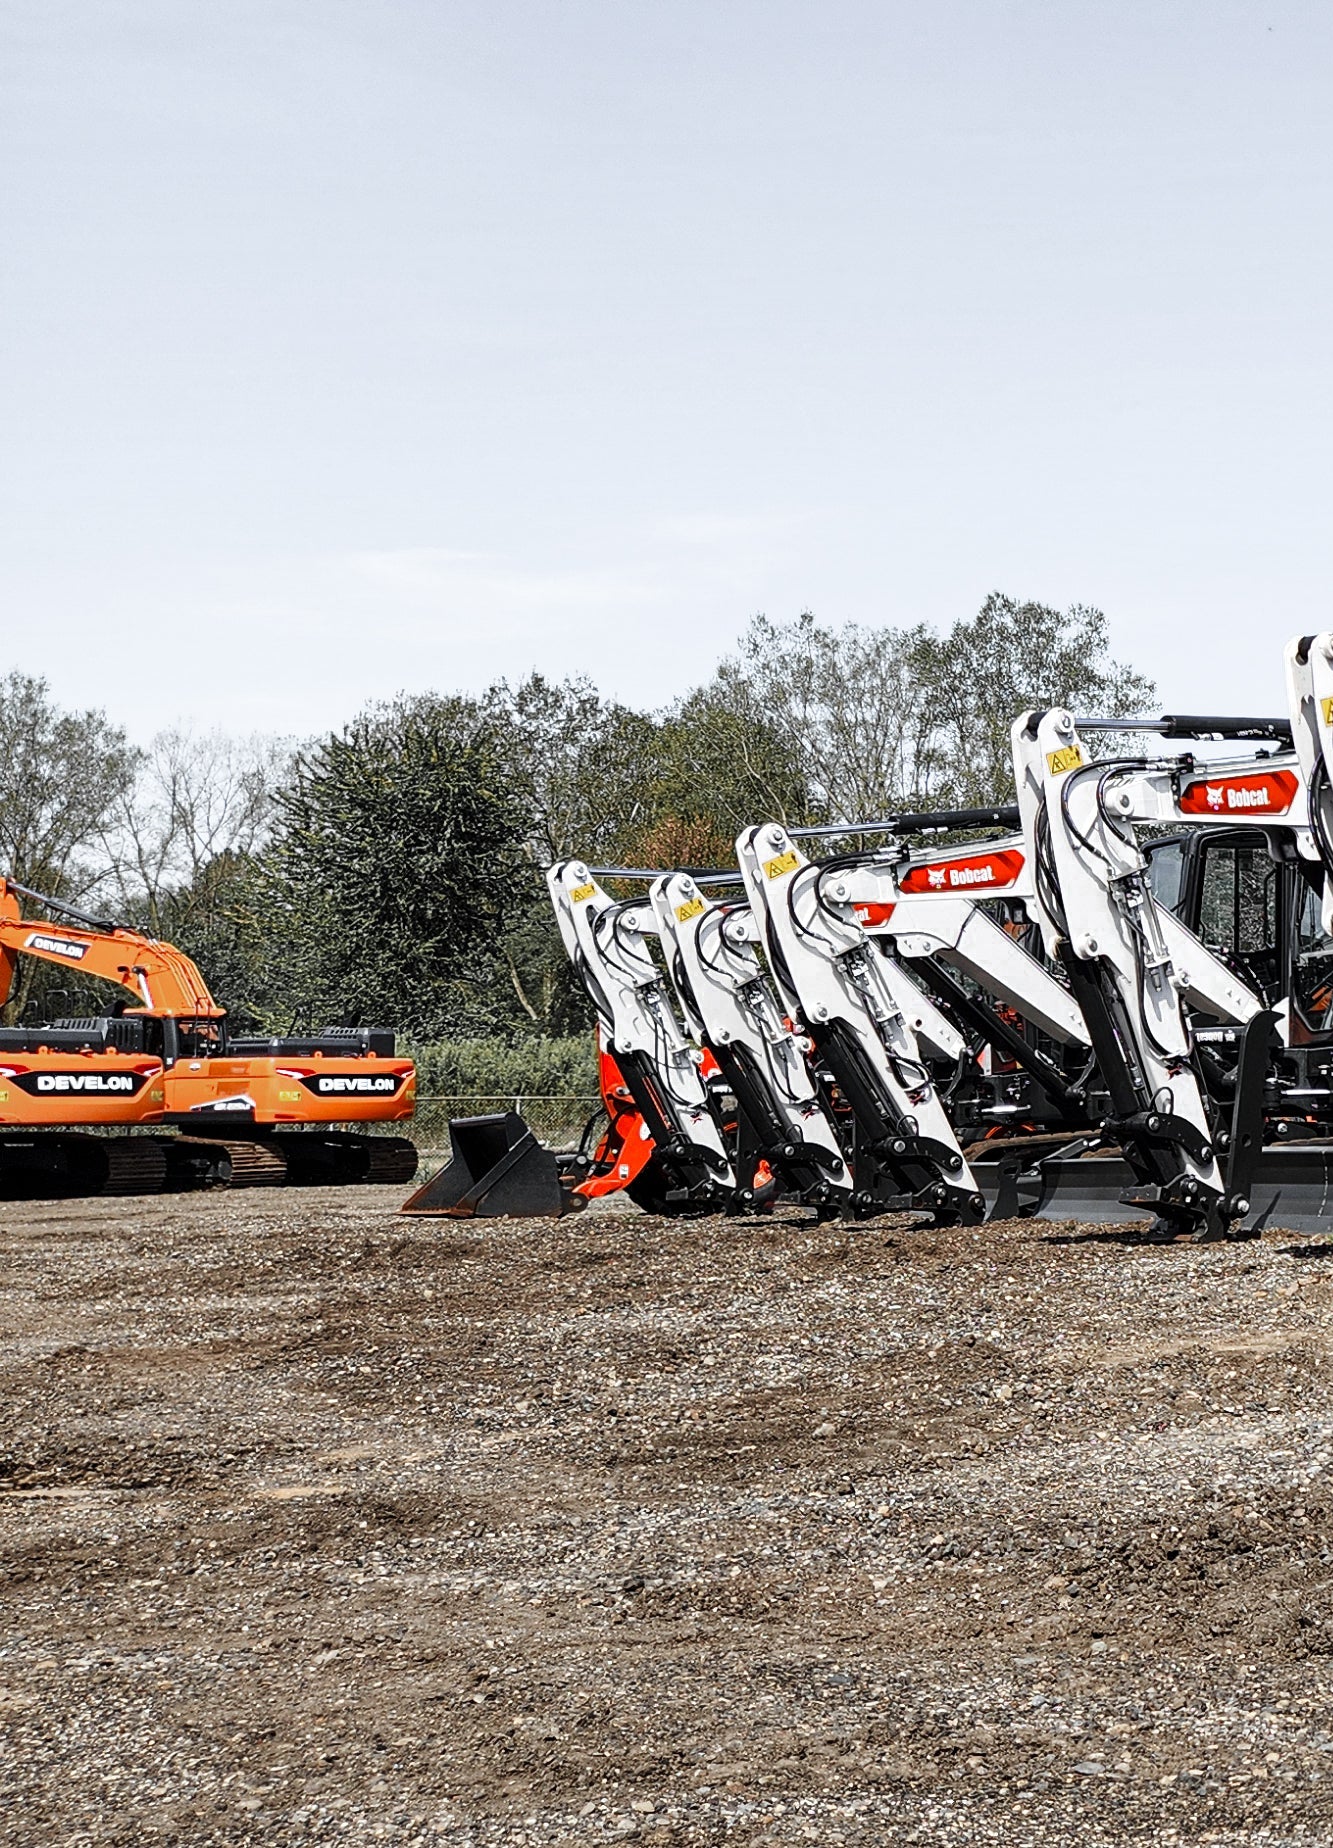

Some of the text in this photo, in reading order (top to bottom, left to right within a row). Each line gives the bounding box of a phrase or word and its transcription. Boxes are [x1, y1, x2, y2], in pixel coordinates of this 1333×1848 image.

[1227, 787, 1269, 808] Bobcat
[949, 866, 995, 886] Bobcat
[34, 938, 84, 958] DEVELON
[37, 1075, 133, 1091] DEVELON
[319, 1078, 395, 1091] DEVELON
